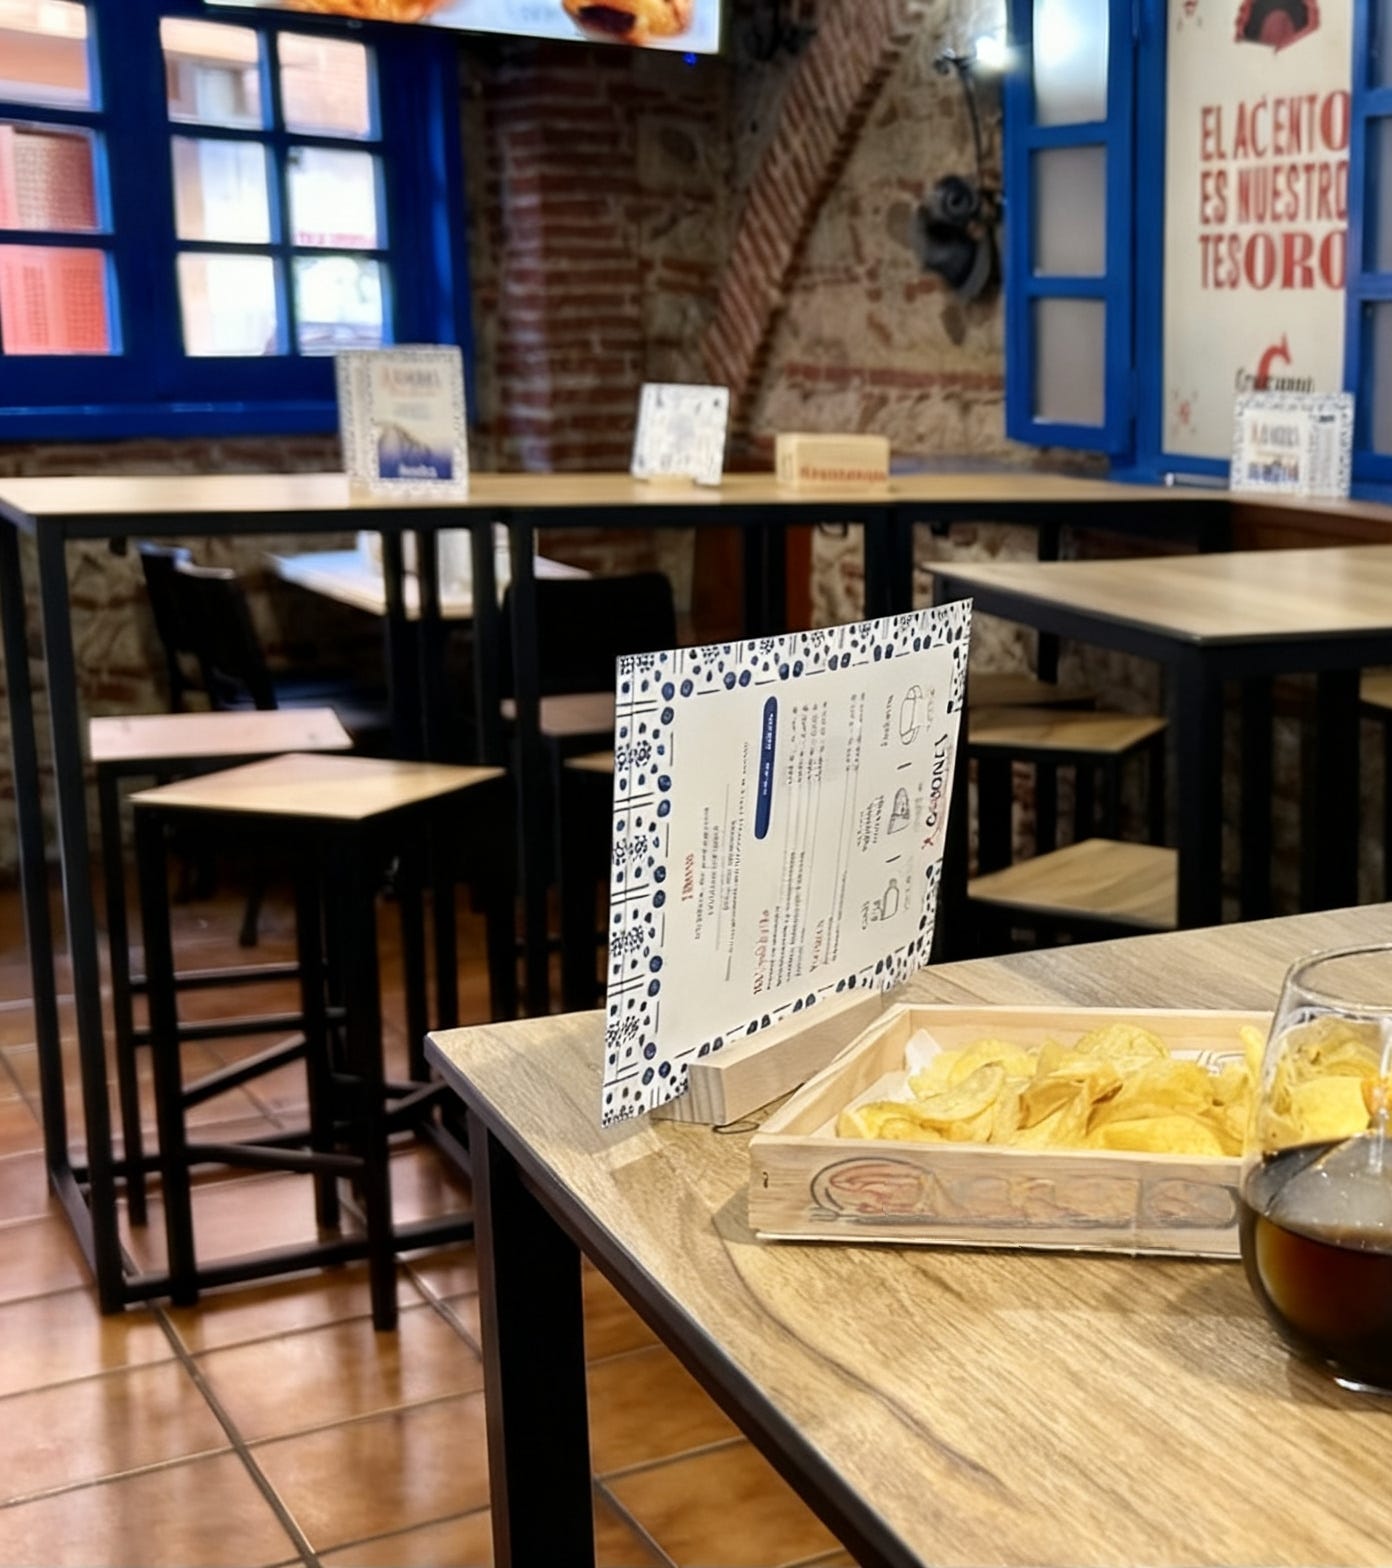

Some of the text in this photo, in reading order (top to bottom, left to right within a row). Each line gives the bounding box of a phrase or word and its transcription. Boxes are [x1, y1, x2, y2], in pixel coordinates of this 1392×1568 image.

[1201, 105, 1226, 161] EL
[1201, 160, 1348, 224] ES NUESTRO
[1199, 230, 1347, 291] TESORO
